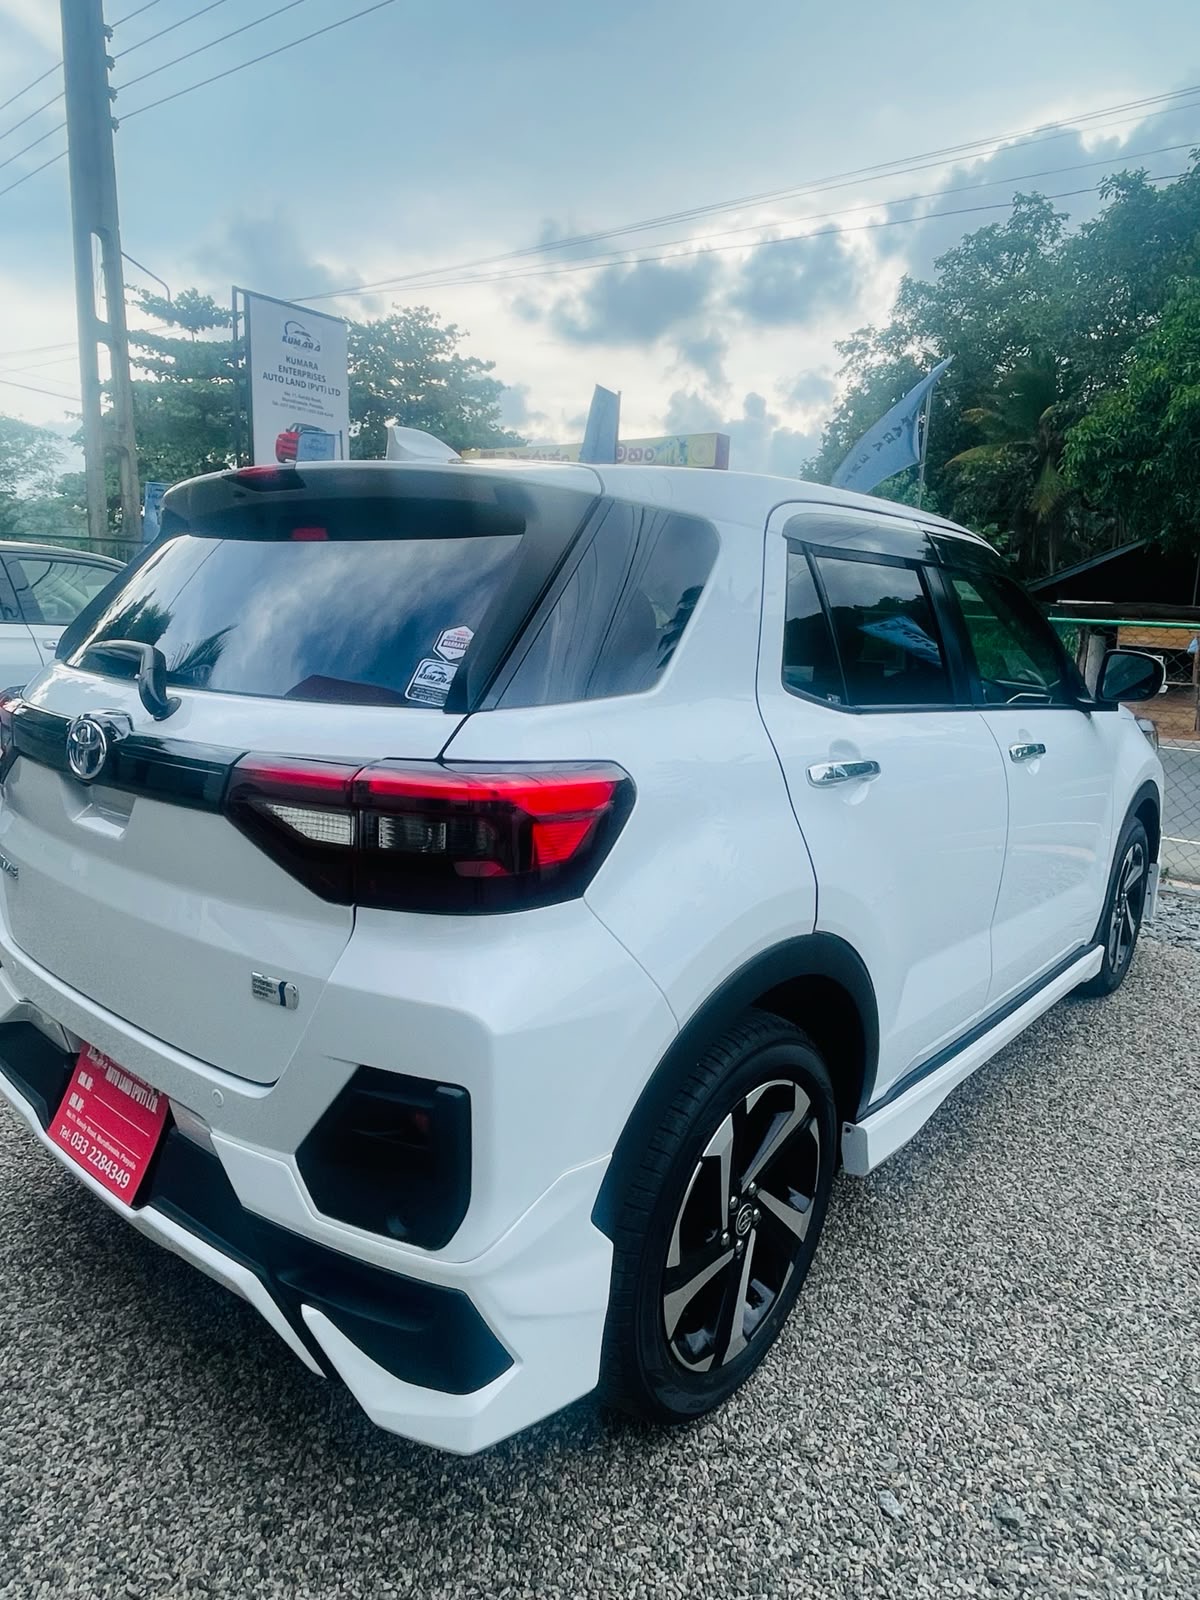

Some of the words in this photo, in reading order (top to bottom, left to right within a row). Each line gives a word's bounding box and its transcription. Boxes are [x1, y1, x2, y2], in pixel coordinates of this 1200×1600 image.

[282, 335, 321, 352] KUMARA
[286, 355, 318, 371] KUMARA
[278, 365, 326, 383] ENTERPRISES
[263, 372, 284, 384] AUTO
[286, 377, 306, 389] LAND
[308, 382, 327, 394] (PVT)
[328, 387, 341, 397] LTD
[60, 1124, 71, 1141] Tel:
[70, 1131, 89, 1155] 033
[87, 1146, 131, 1189] 2284349
